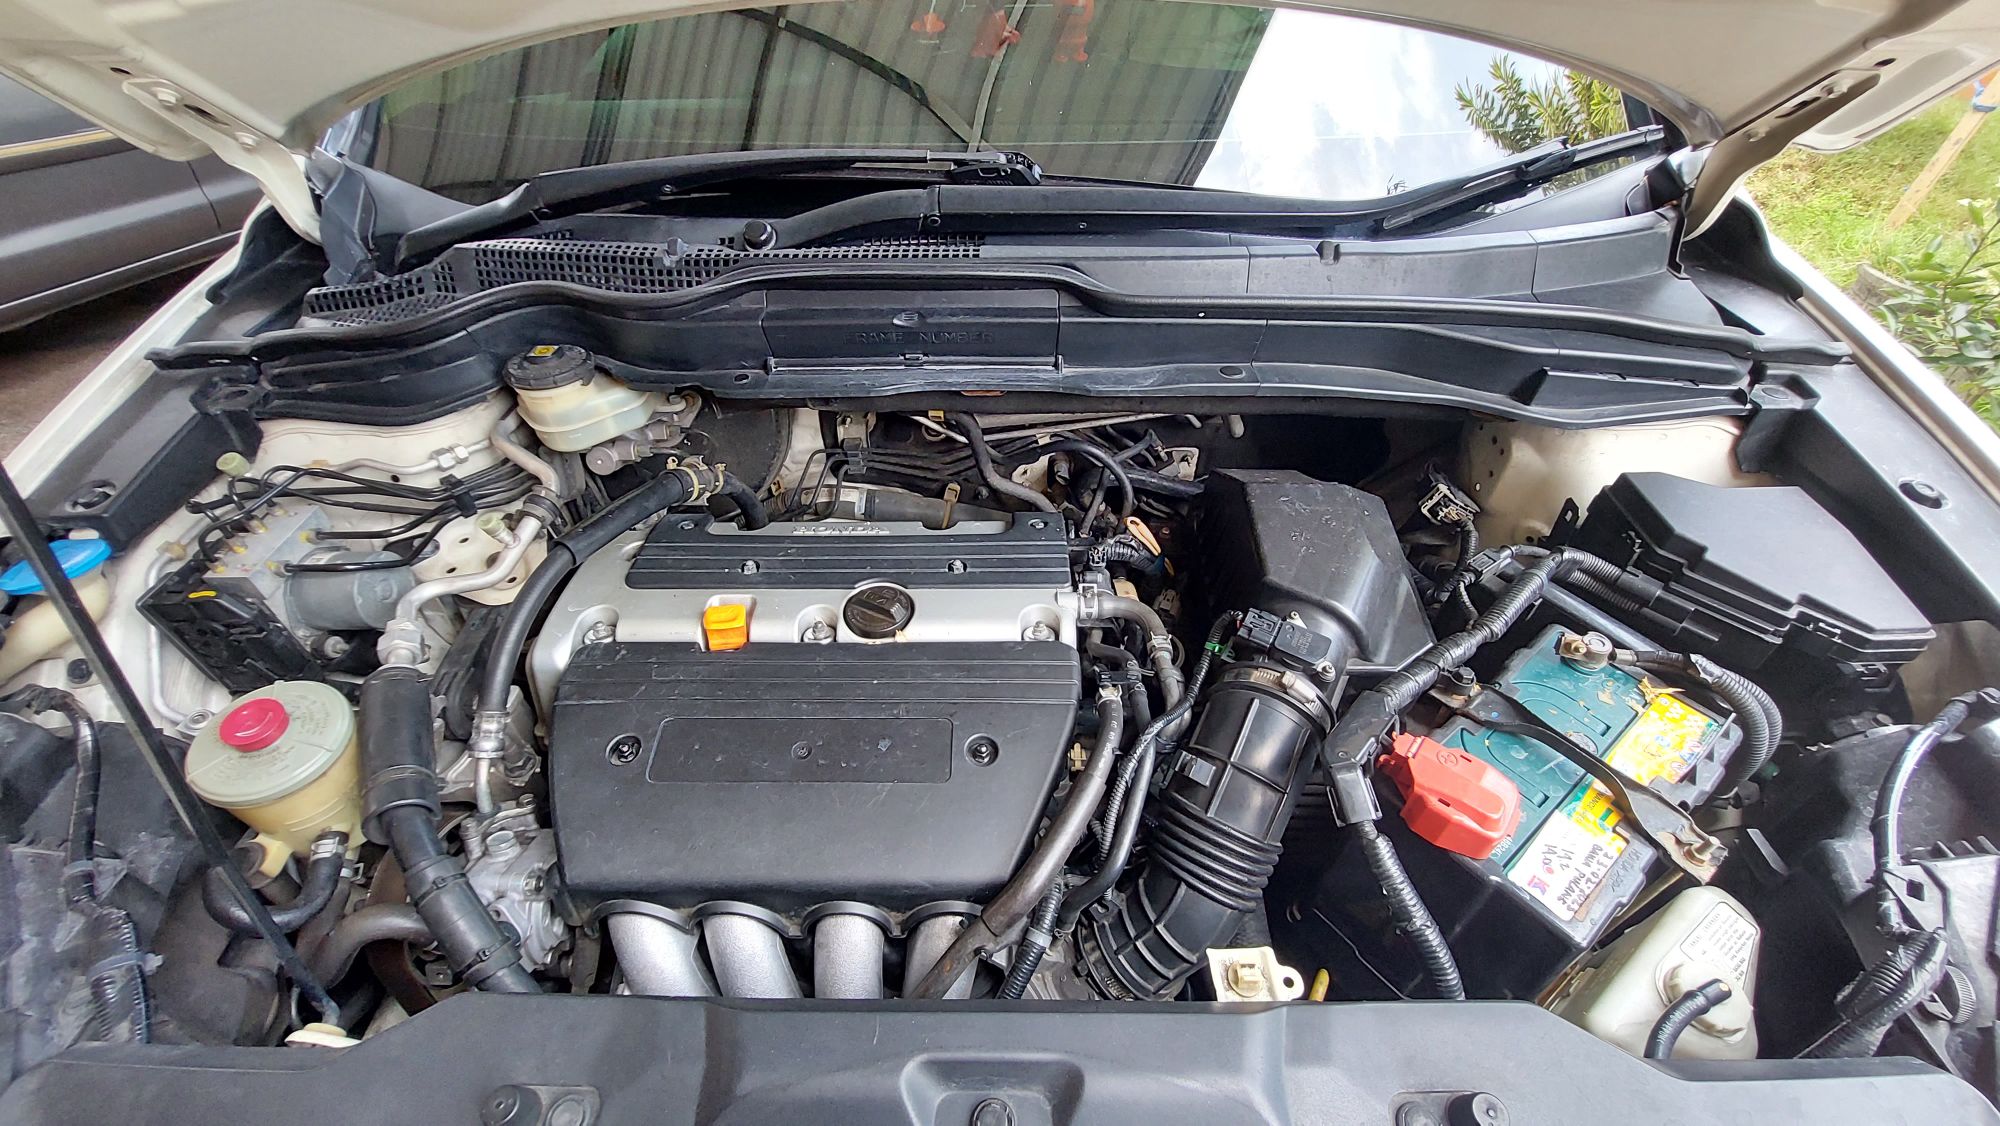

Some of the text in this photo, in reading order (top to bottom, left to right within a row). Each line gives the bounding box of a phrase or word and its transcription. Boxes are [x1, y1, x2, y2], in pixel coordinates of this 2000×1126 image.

[843, 332, 994, 344] FRAME NUMBER
[792, 526, 890, 535] HONDA
